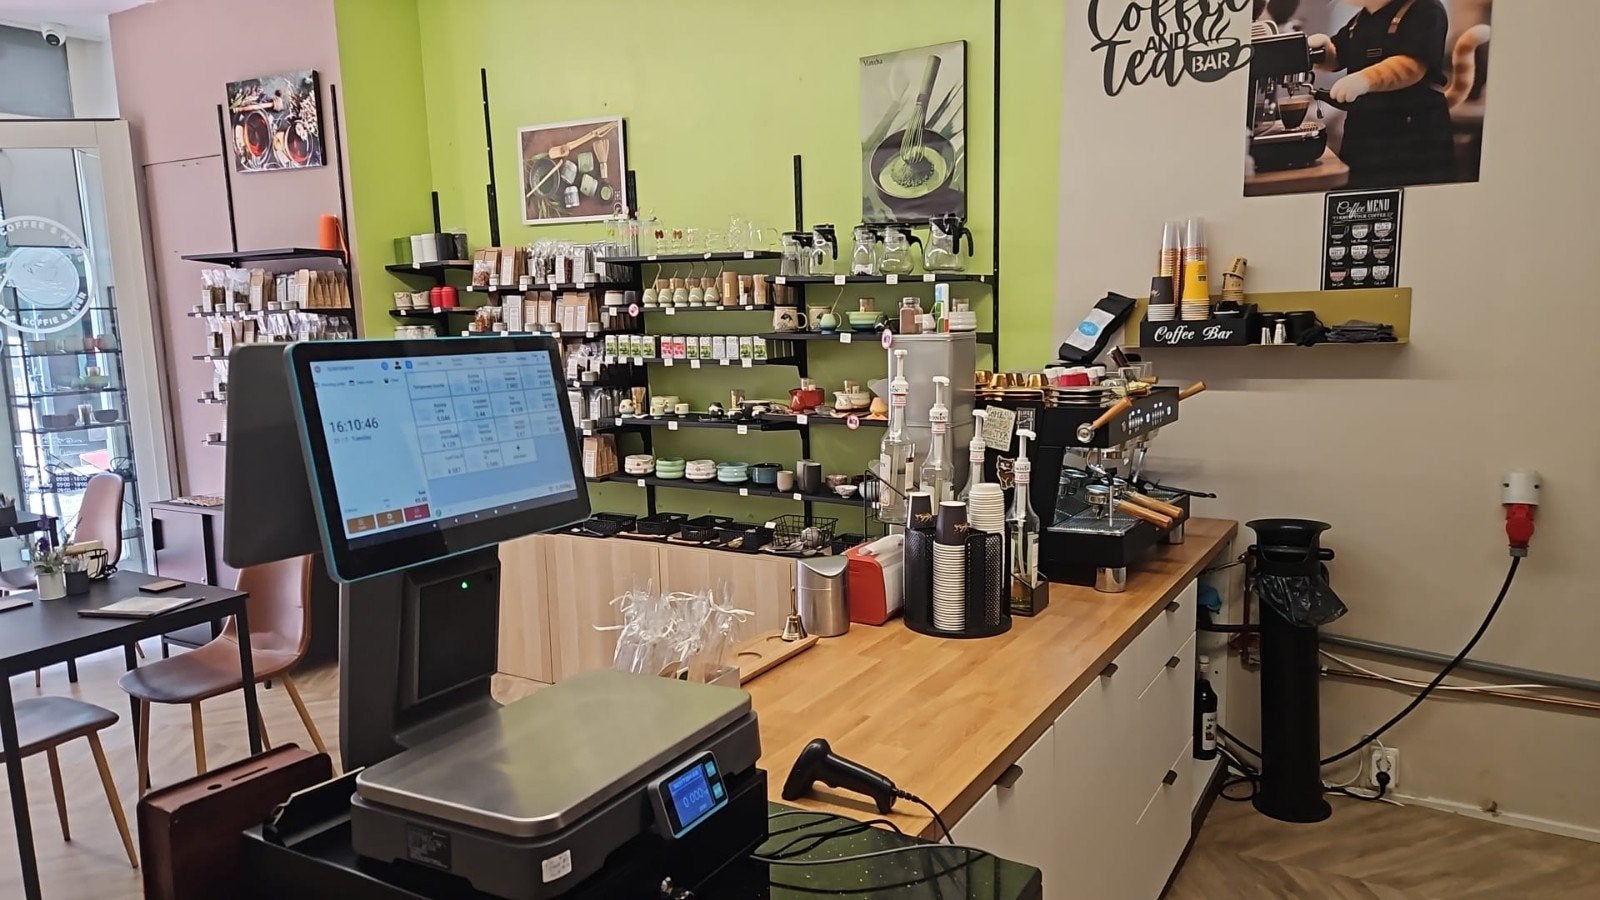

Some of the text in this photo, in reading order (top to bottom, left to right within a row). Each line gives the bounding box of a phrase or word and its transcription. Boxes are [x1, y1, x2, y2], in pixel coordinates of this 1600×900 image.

[1144, 32, 1189, 55] AND
[1091, 39, 1185, 97] Tea
[1192, 51, 1230, 73] BAR
[1337, 198, 1390, 218] Coffee MENU
[22, 315, 59, 326] KOFFIE
[1154, 325, 1233, 345] Coffee Bar
[329, 417, 379, 433] 16:10:46
